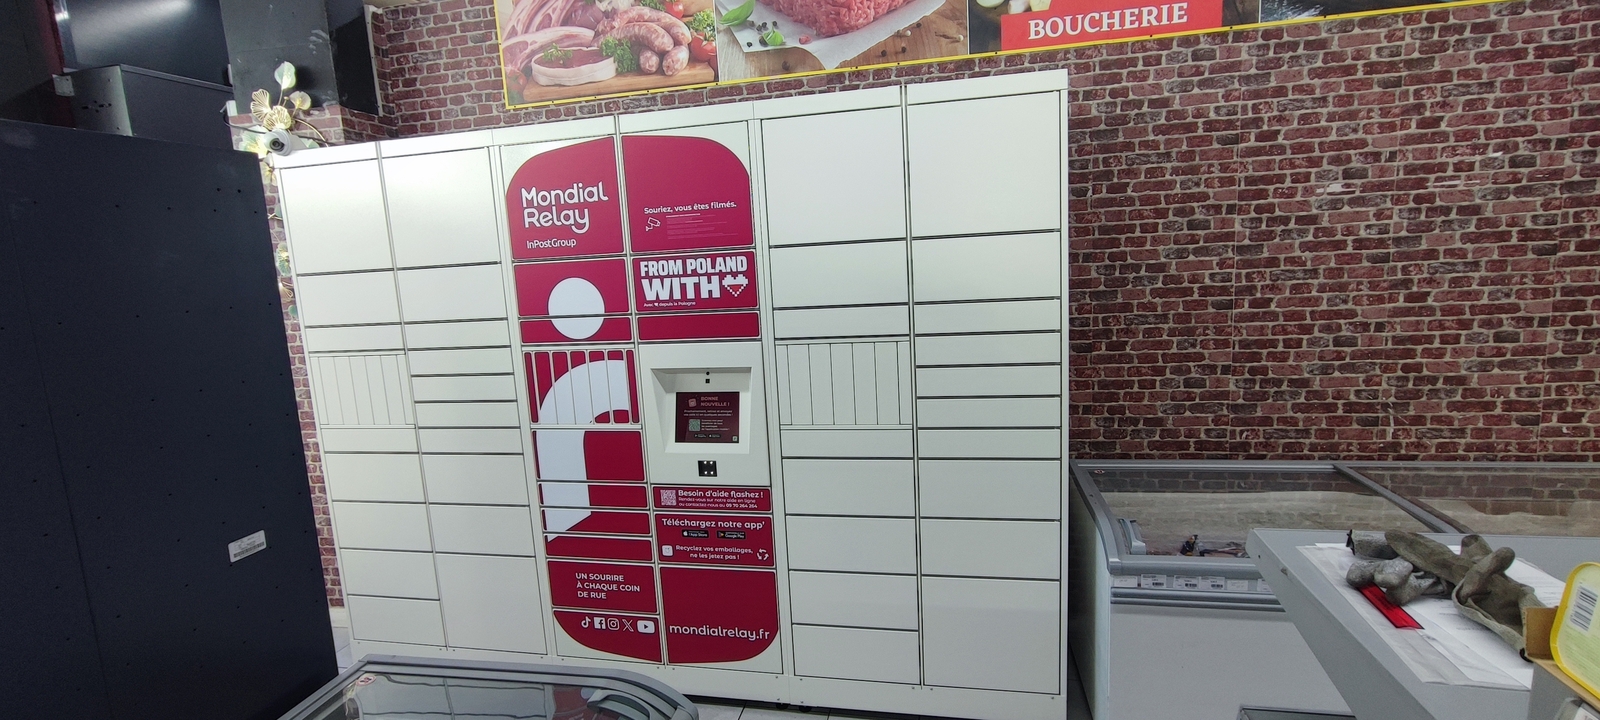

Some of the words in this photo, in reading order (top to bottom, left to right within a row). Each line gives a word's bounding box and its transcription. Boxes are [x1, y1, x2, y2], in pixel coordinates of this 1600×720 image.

[1028, 2, 1188, 40] BOUCHERIE
[521, 181, 609, 207] Mondial
[644, 205, 673, 214] Souriez,
[693, 202, 710, 211] êtes
[711, 200, 737, 209] filmés.
[523, 206, 590, 234] Relay
[640, 259, 684, 277] FROM
[686, 255, 748, 275] POLAND
[641, 275, 721, 301] WITH
[678, 489, 704, 497] Besoin
[705, 489, 729, 498] d'aide
[730, 490, 760, 498] flashez
[661, 518, 716, 529] Téléchargez
[718, 520, 742, 528] notre
[744, 521, 765, 530] app'
[715, 546, 754, 554] emballages,
[575, 572, 588, 580] UN
[589, 573, 625, 582] SOURIRE
[576, 580, 583, 589] À
[583, 582, 618, 591] CHAQUE
[619, 584, 640, 592] COIN
[590, 591, 607, 599] RUE
[669, 624, 770, 641] mondialrelay.fr
